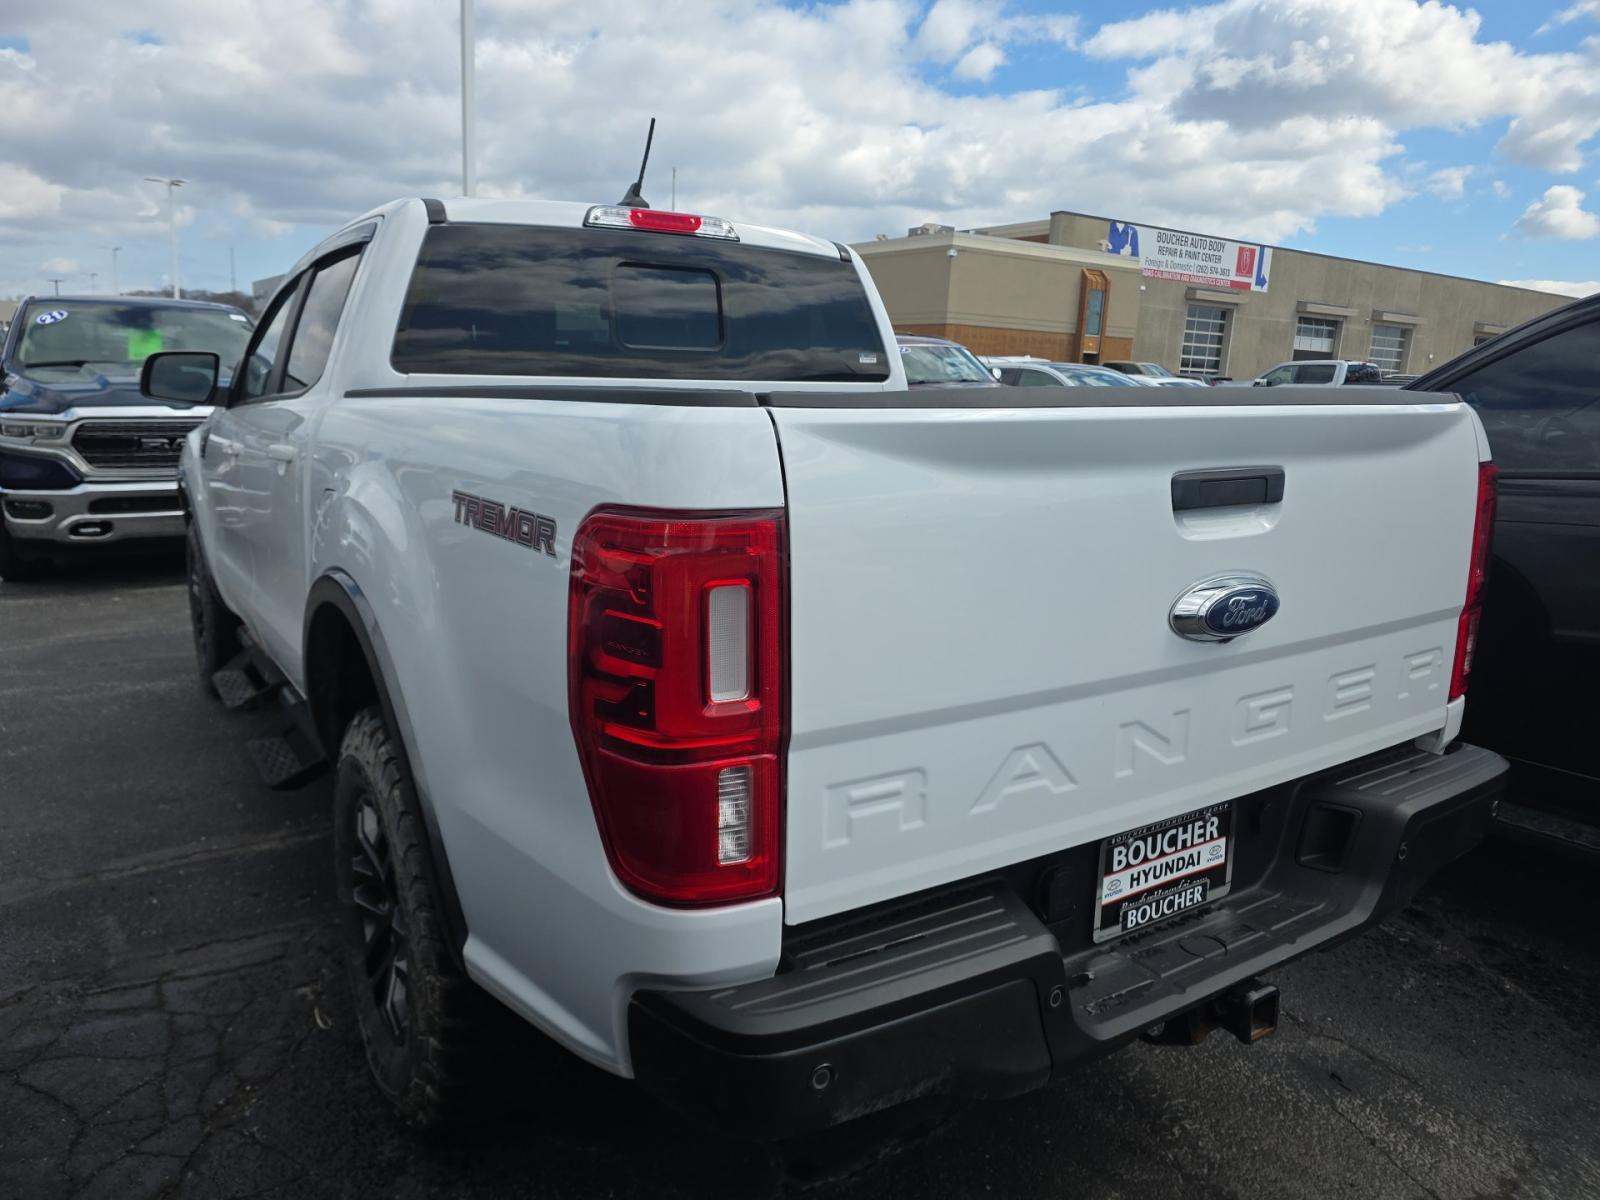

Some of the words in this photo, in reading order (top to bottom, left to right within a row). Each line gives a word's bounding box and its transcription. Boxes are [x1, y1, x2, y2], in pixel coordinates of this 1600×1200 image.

[1157, 232, 1189, 247] BOUCHER
[1189, 236, 1207, 250] AUTO
[1209, 240, 1226, 253] BODY
[1157, 245, 1178, 258] REPAIR
[1178, 248, 1184, 258] &
[1184, 249, 1200, 260] PAINT
[1201, 252, 1222, 264] CENTER
[452, 488, 558, 559] TREMOR
[1222, 594, 1269, 628] Ford
[822, 646, 1443, 850] RANGER
[1112, 816, 1219, 872] BOUCHER
[1129, 851, 1202, 889] HYUNDAI
[1127, 885, 1203, 929] BOUCHER
